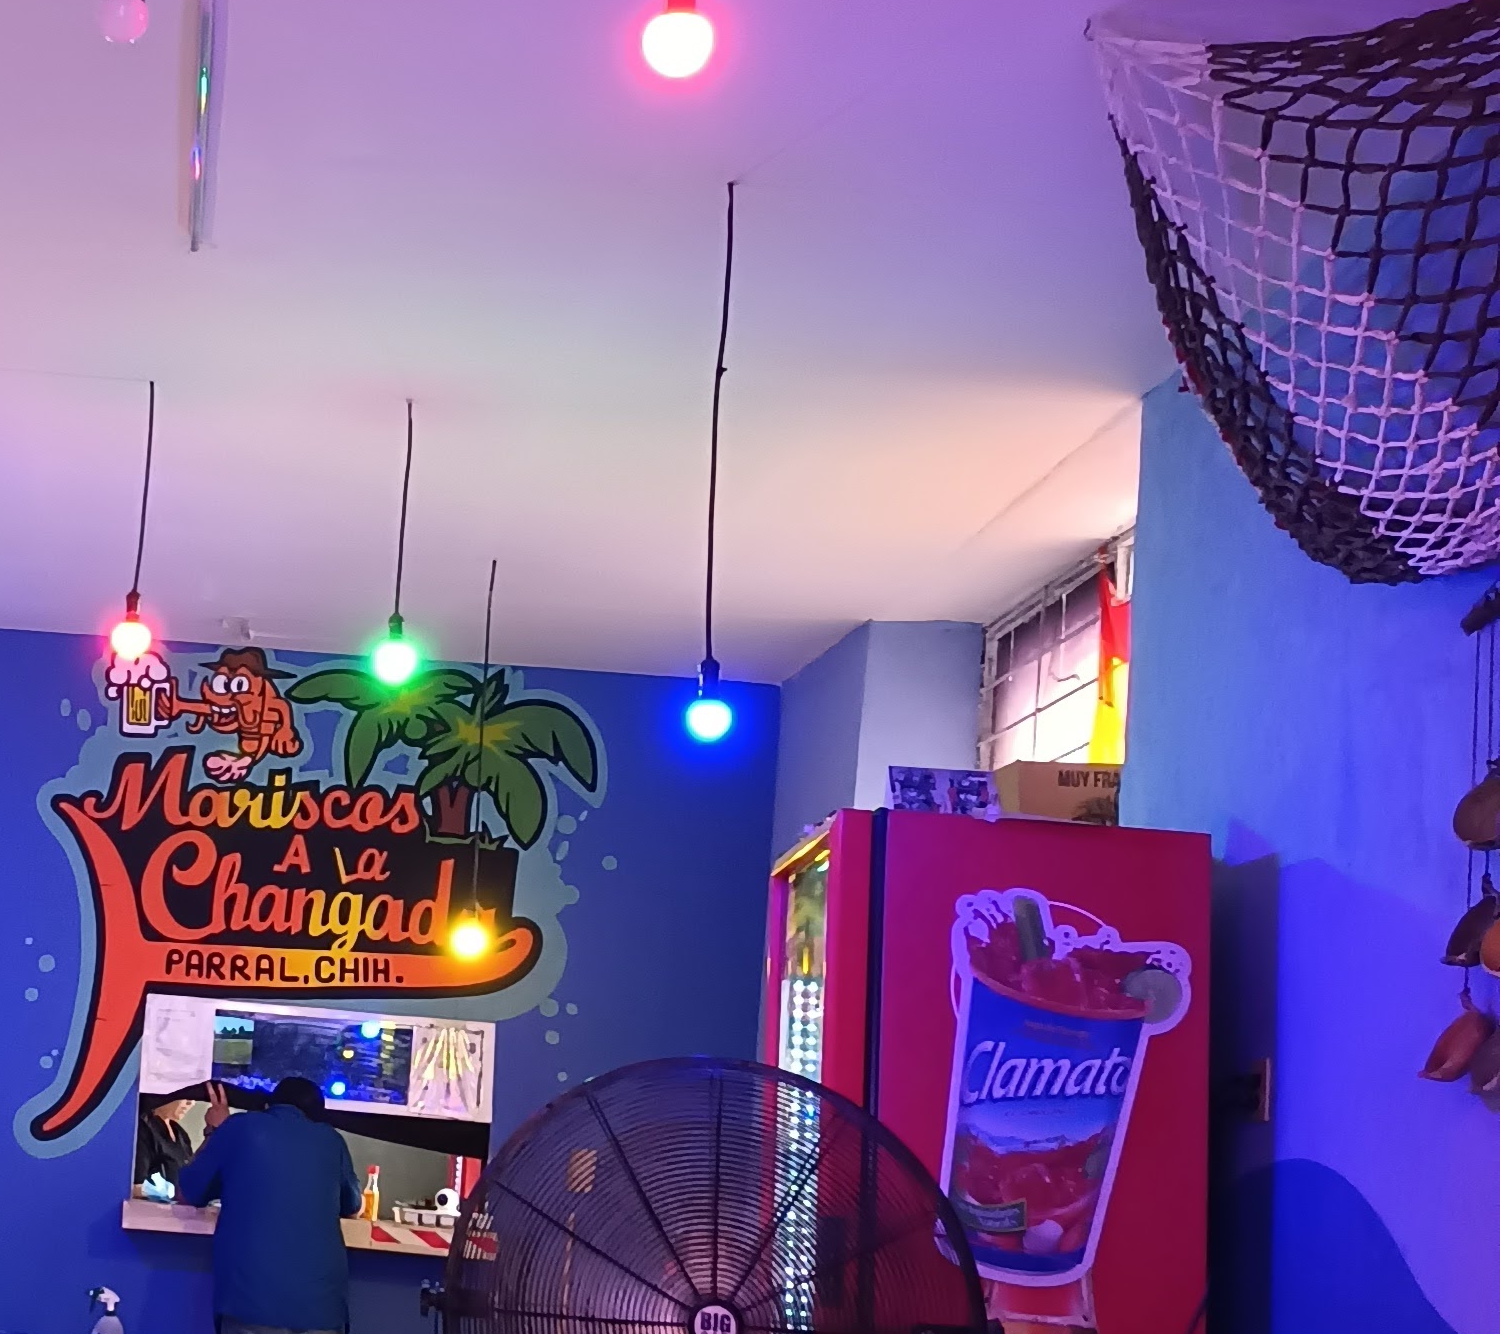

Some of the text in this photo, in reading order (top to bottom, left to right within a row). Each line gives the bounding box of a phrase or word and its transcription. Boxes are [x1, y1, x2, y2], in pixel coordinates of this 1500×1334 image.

[83, 753, 420, 834] Mariscos
[273, 835, 391, 885] A La
[962, 1040, 1132, 1104] Clamato
[700, 1311, 732, 1334] BIG
